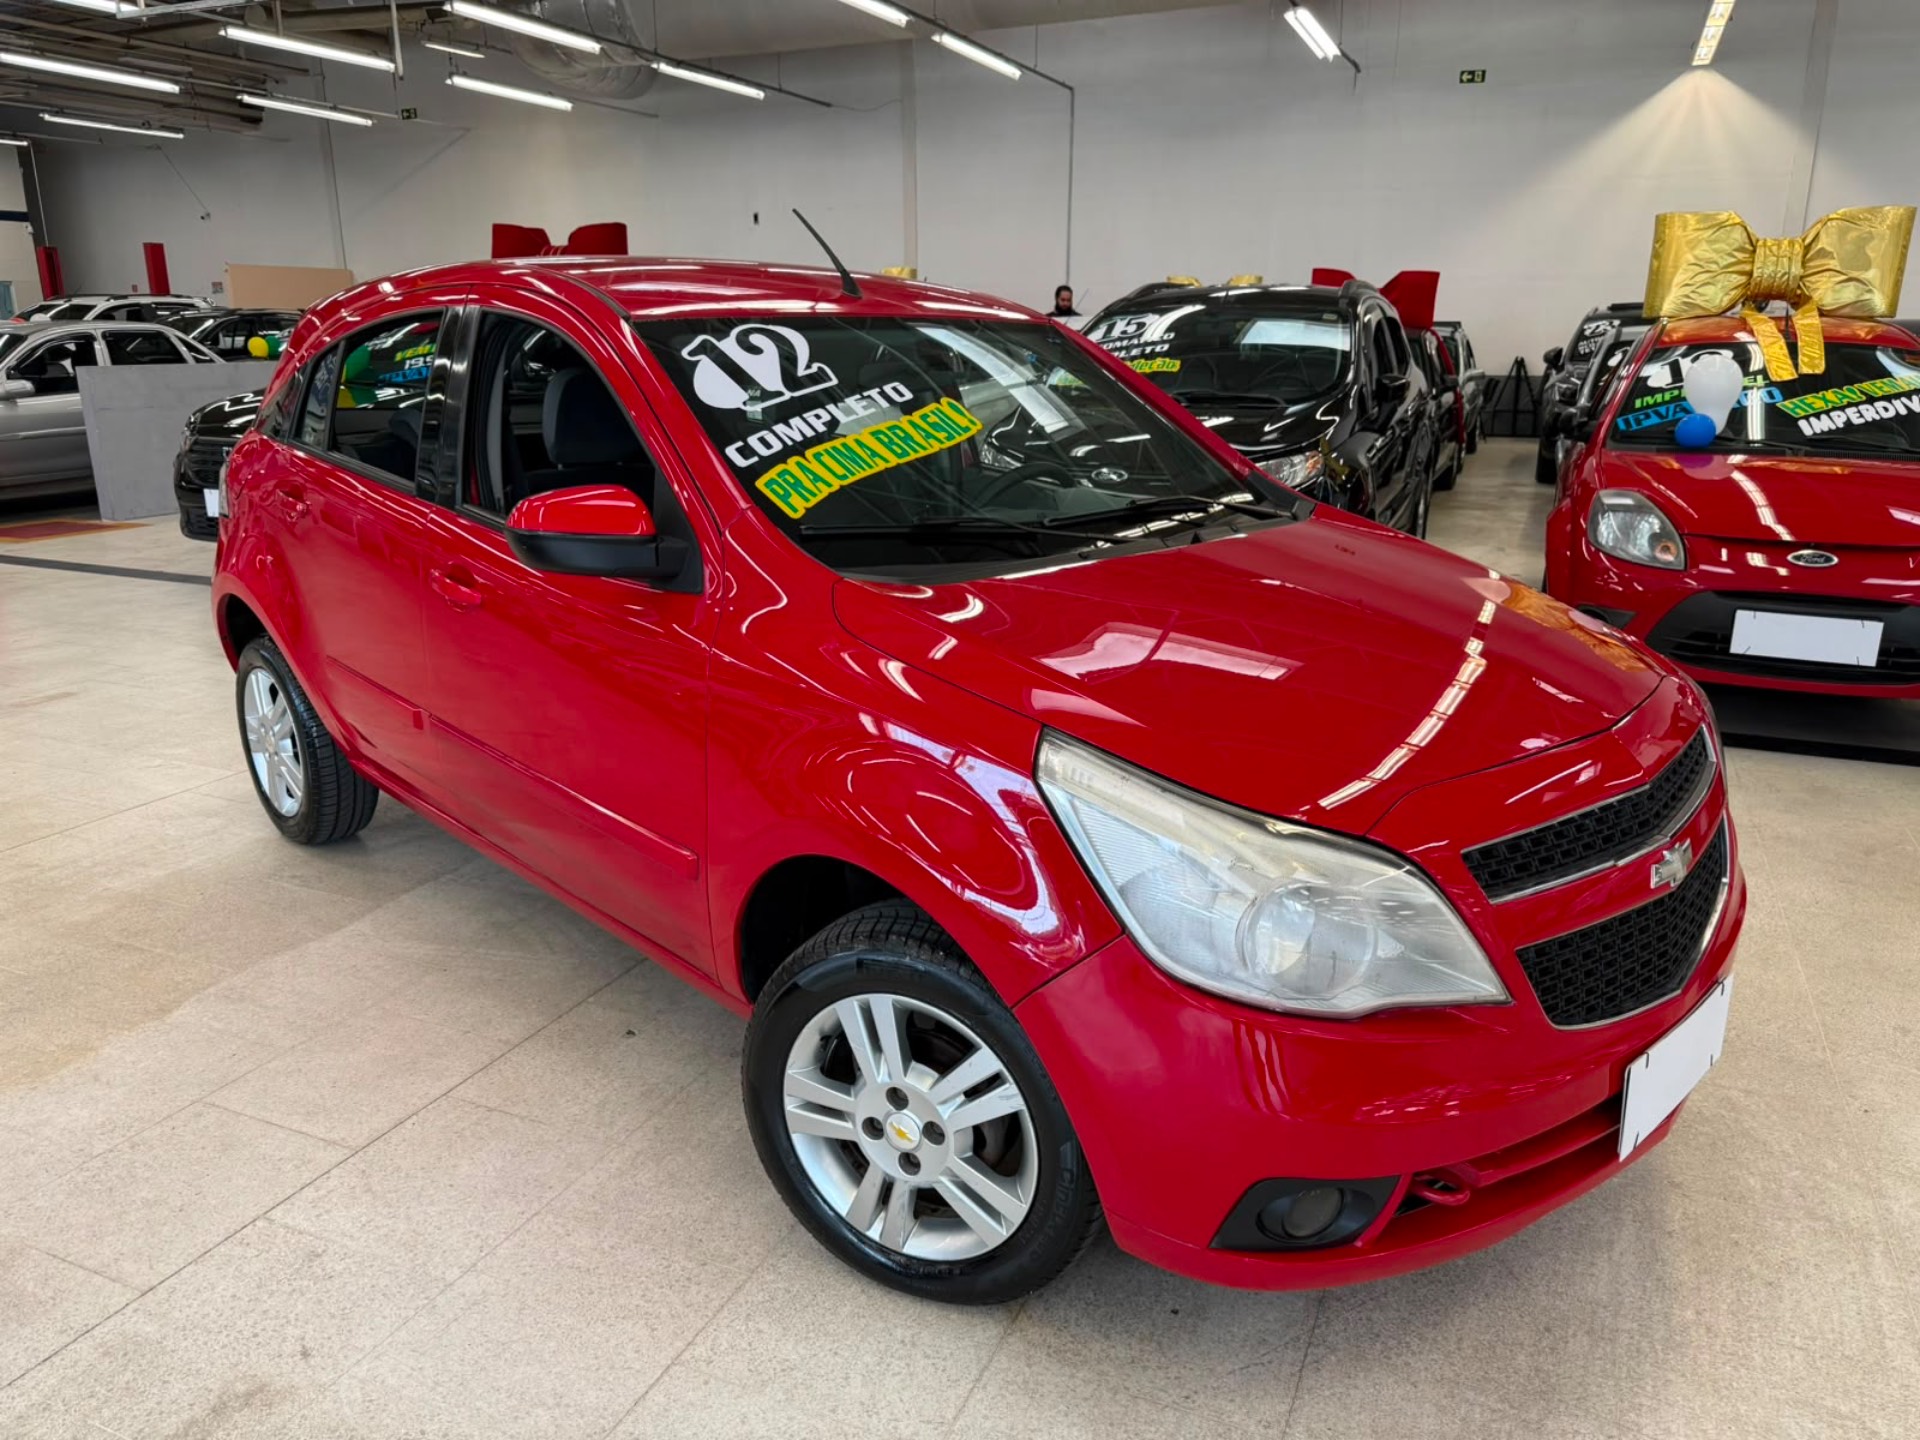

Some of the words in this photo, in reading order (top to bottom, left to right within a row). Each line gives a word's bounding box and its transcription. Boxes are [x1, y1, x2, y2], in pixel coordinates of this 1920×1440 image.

[681, 323, 838, 412] 12
[725, 381, 914, 468] COMPLETO
[1616, 402, 1695, 432] IPVA
[765, 457, 833, 514] PRA
[812, 437, 891, 482] CIMA
